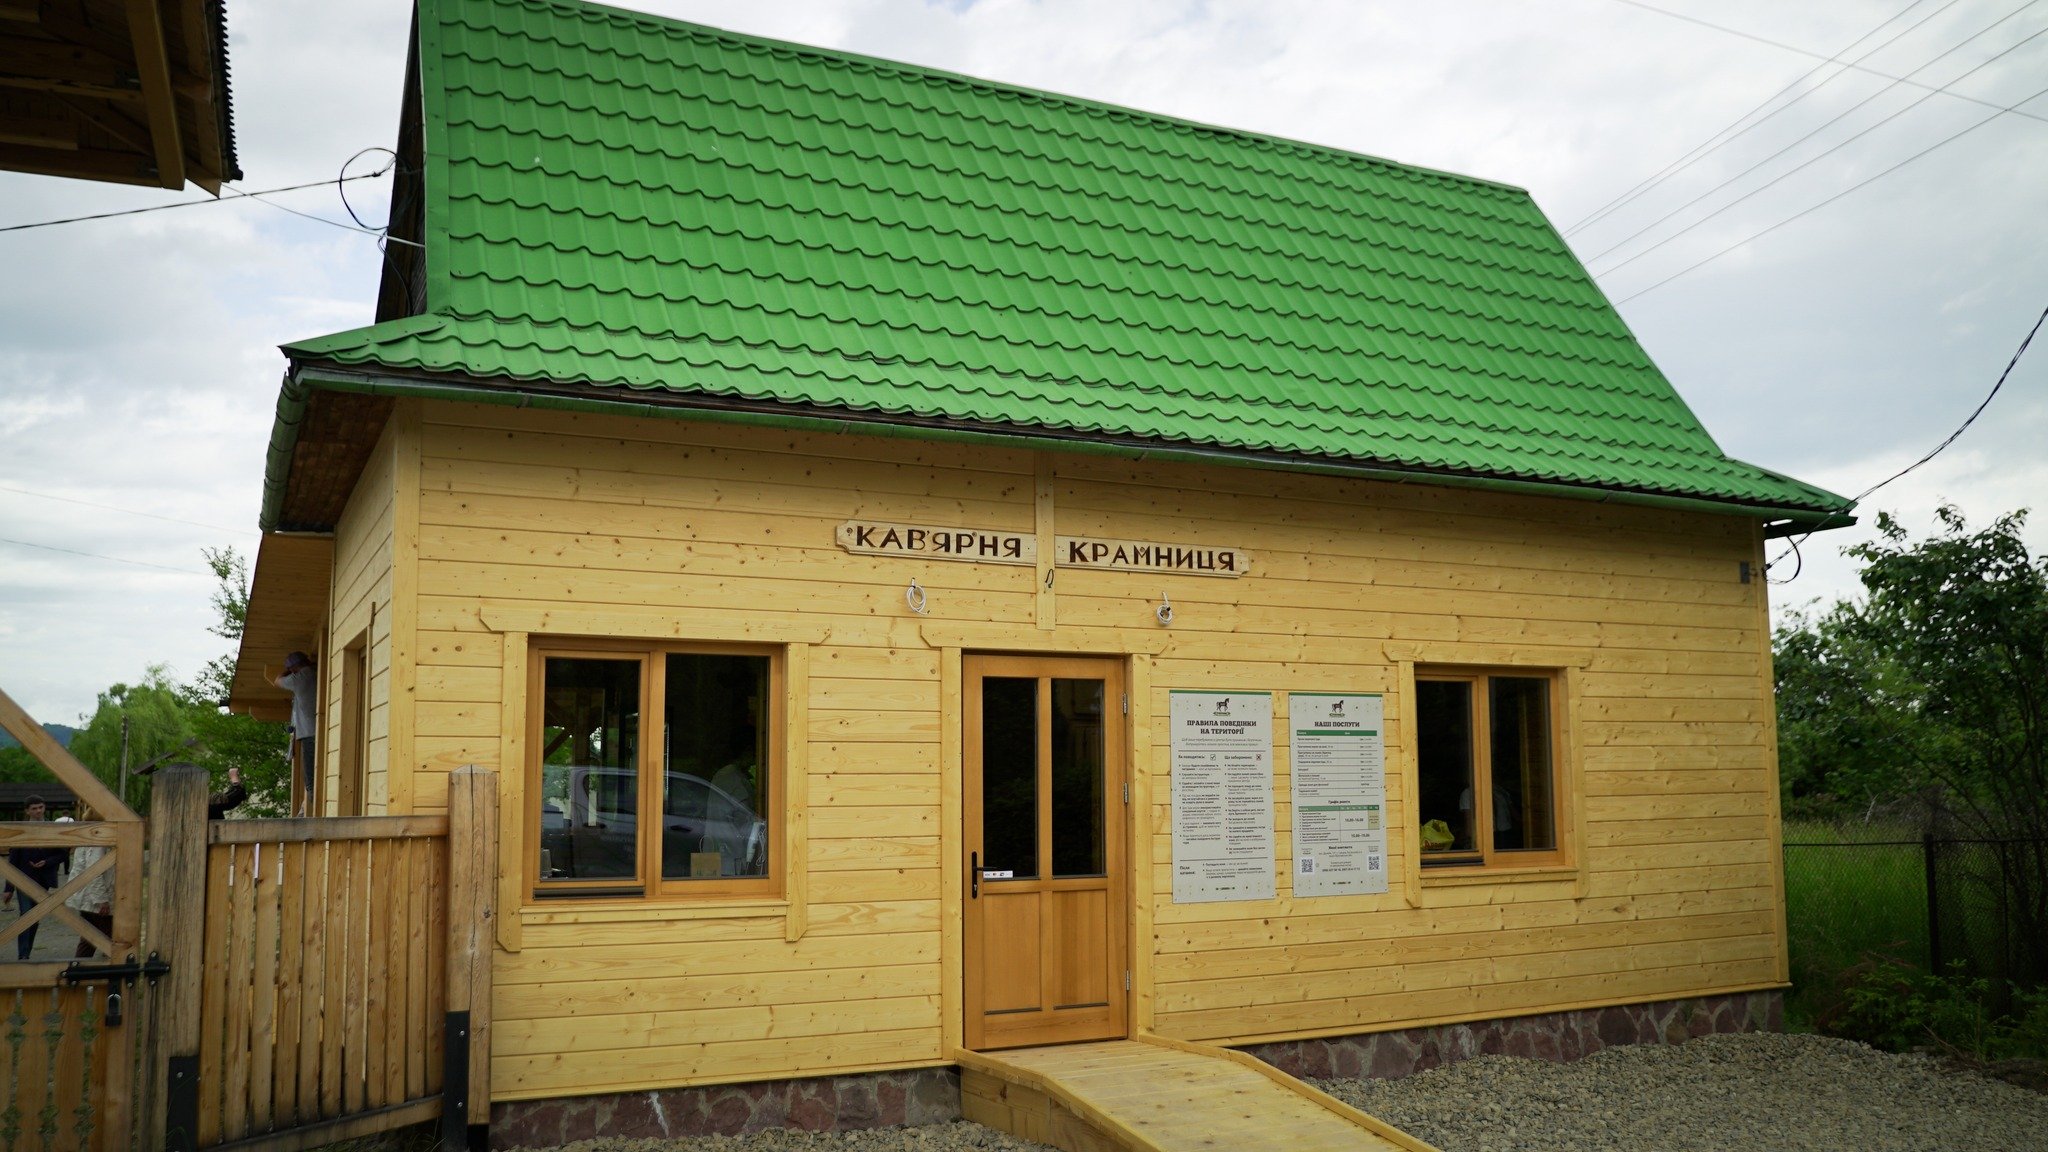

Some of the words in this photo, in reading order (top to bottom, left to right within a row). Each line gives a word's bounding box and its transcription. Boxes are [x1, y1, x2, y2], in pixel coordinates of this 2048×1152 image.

[856, 525, 1021, 558] КАВ'ЯРНЯ
[1068, 541, 1236, 572] КРАМНИЦЯ
[1220, 720, 1257, 728] ПОВЕДІНКИ
